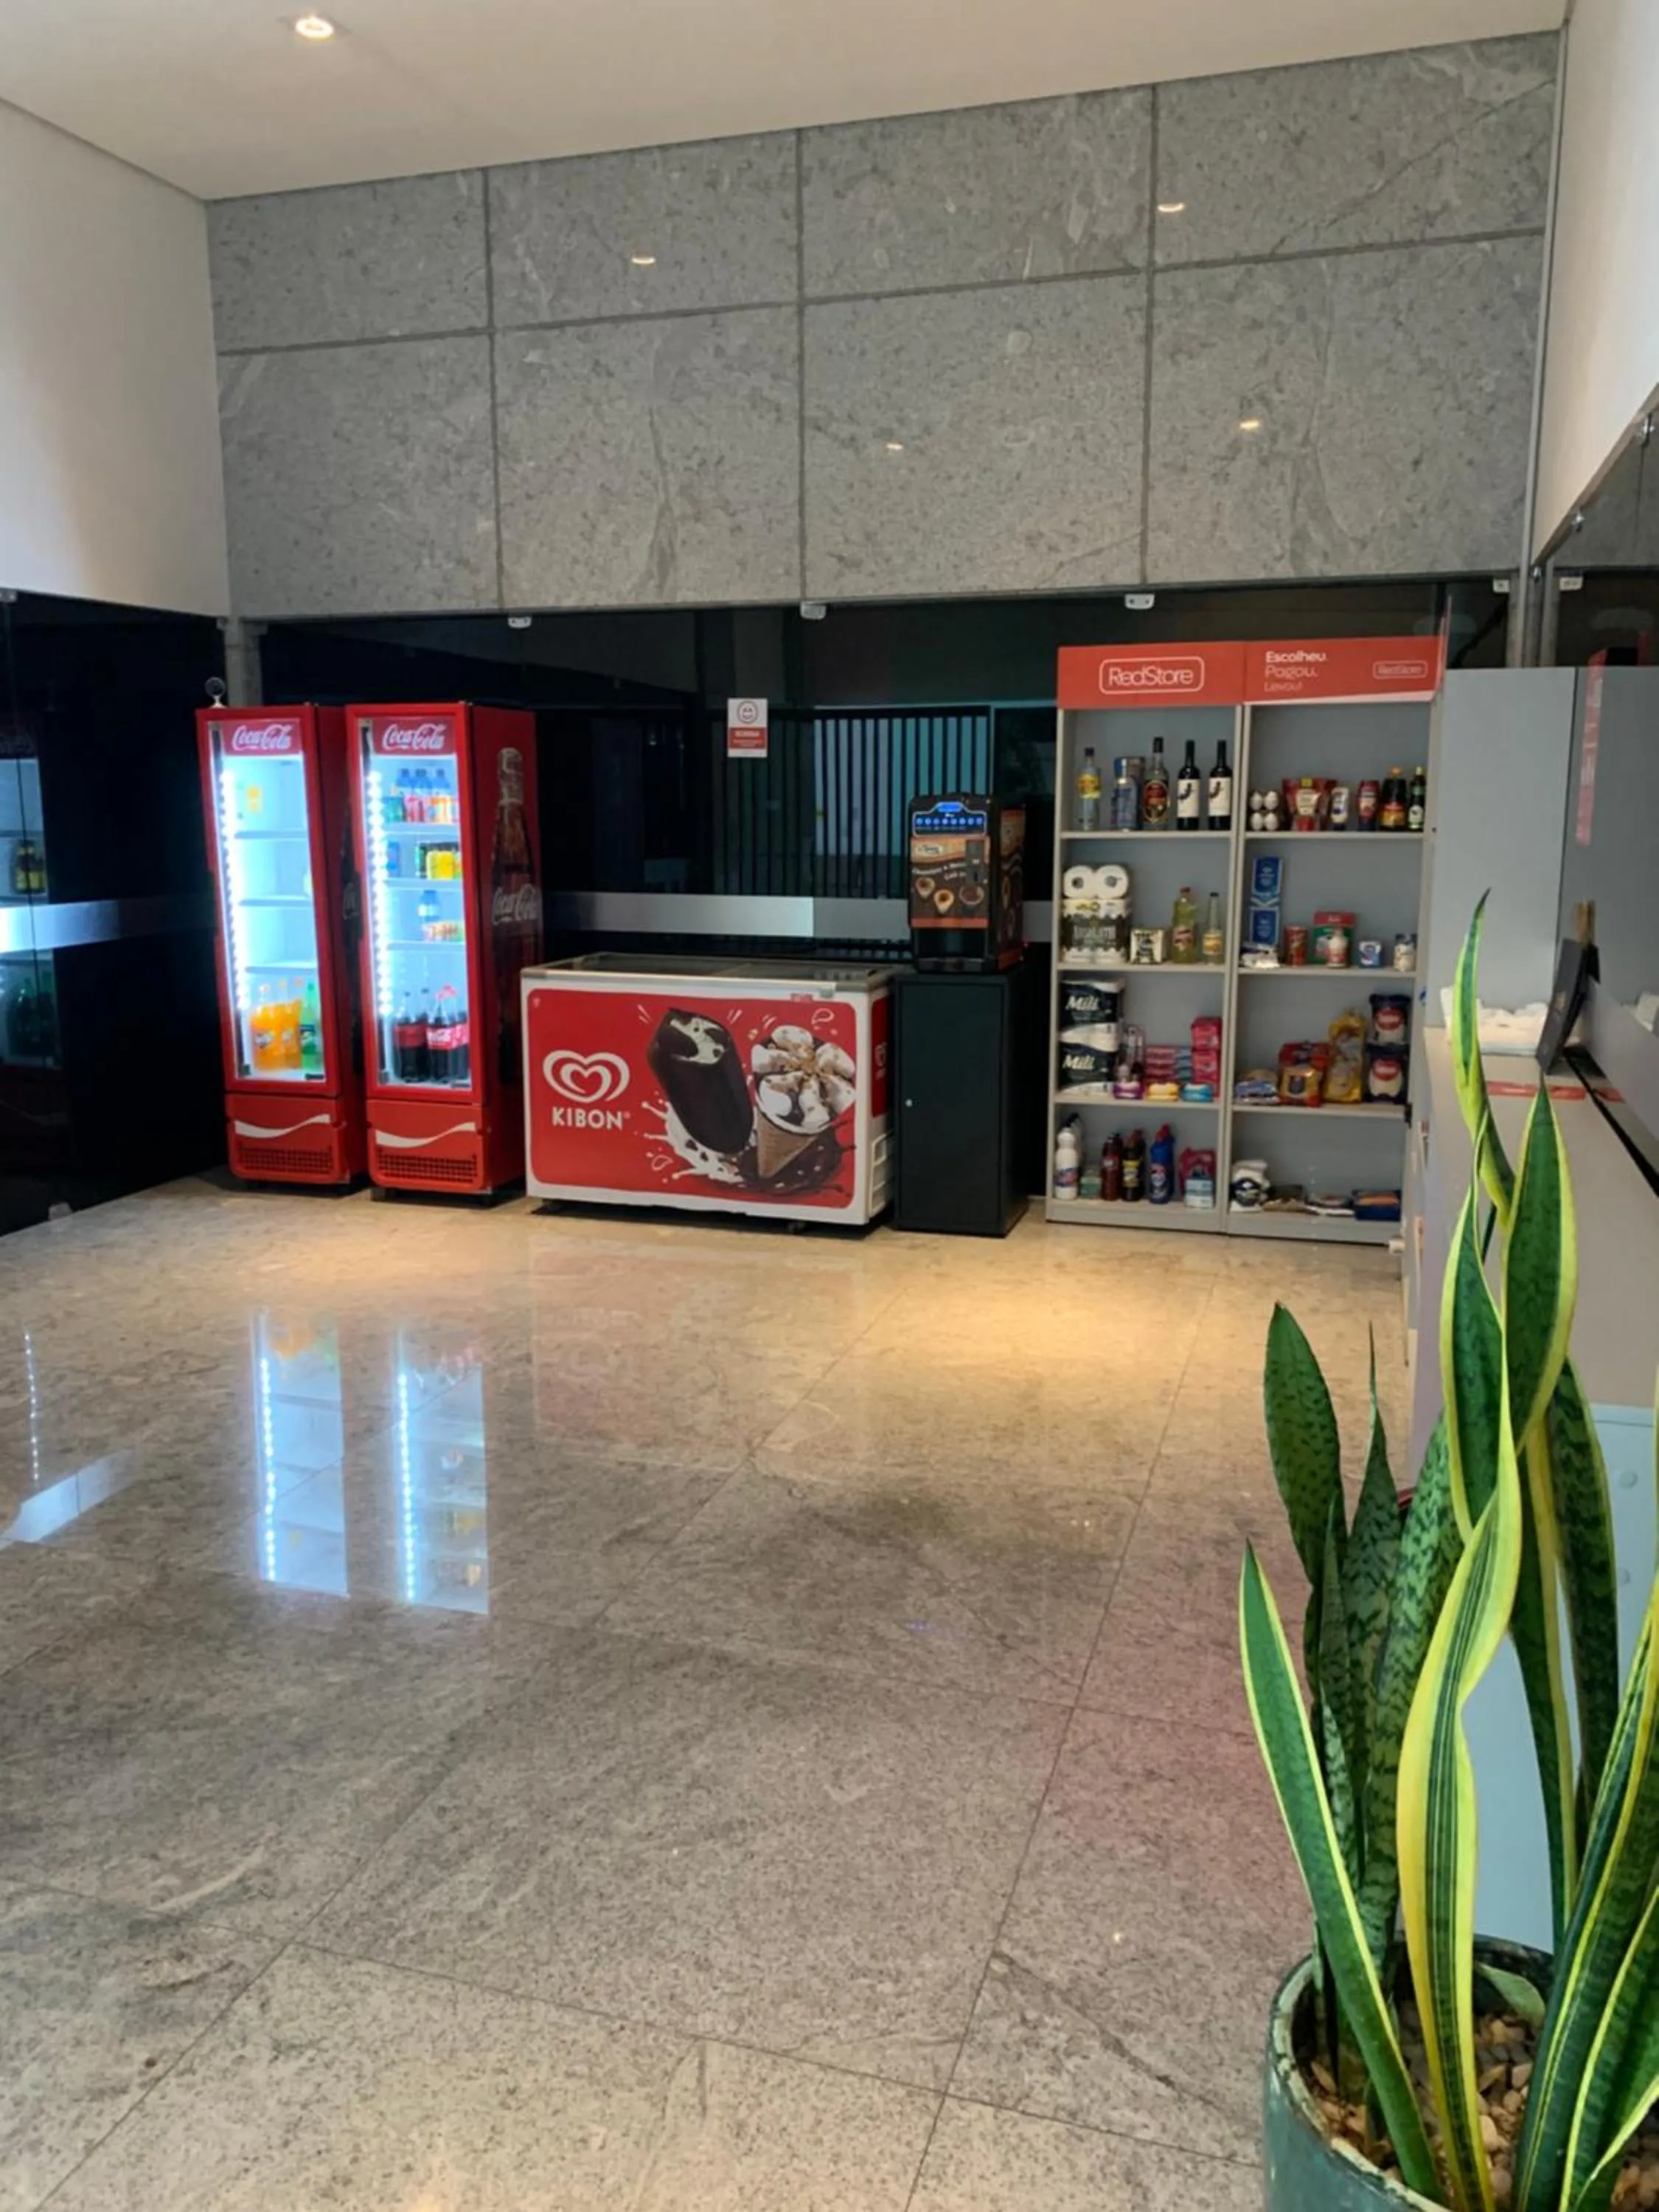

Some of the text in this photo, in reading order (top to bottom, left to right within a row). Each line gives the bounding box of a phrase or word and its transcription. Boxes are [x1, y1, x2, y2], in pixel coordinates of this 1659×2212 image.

[1265, 650, 1327, 663] Escolheu.
[1108, 664, 1194, 686] RedStore
[552, 1106, 622, 1131] KIBON
